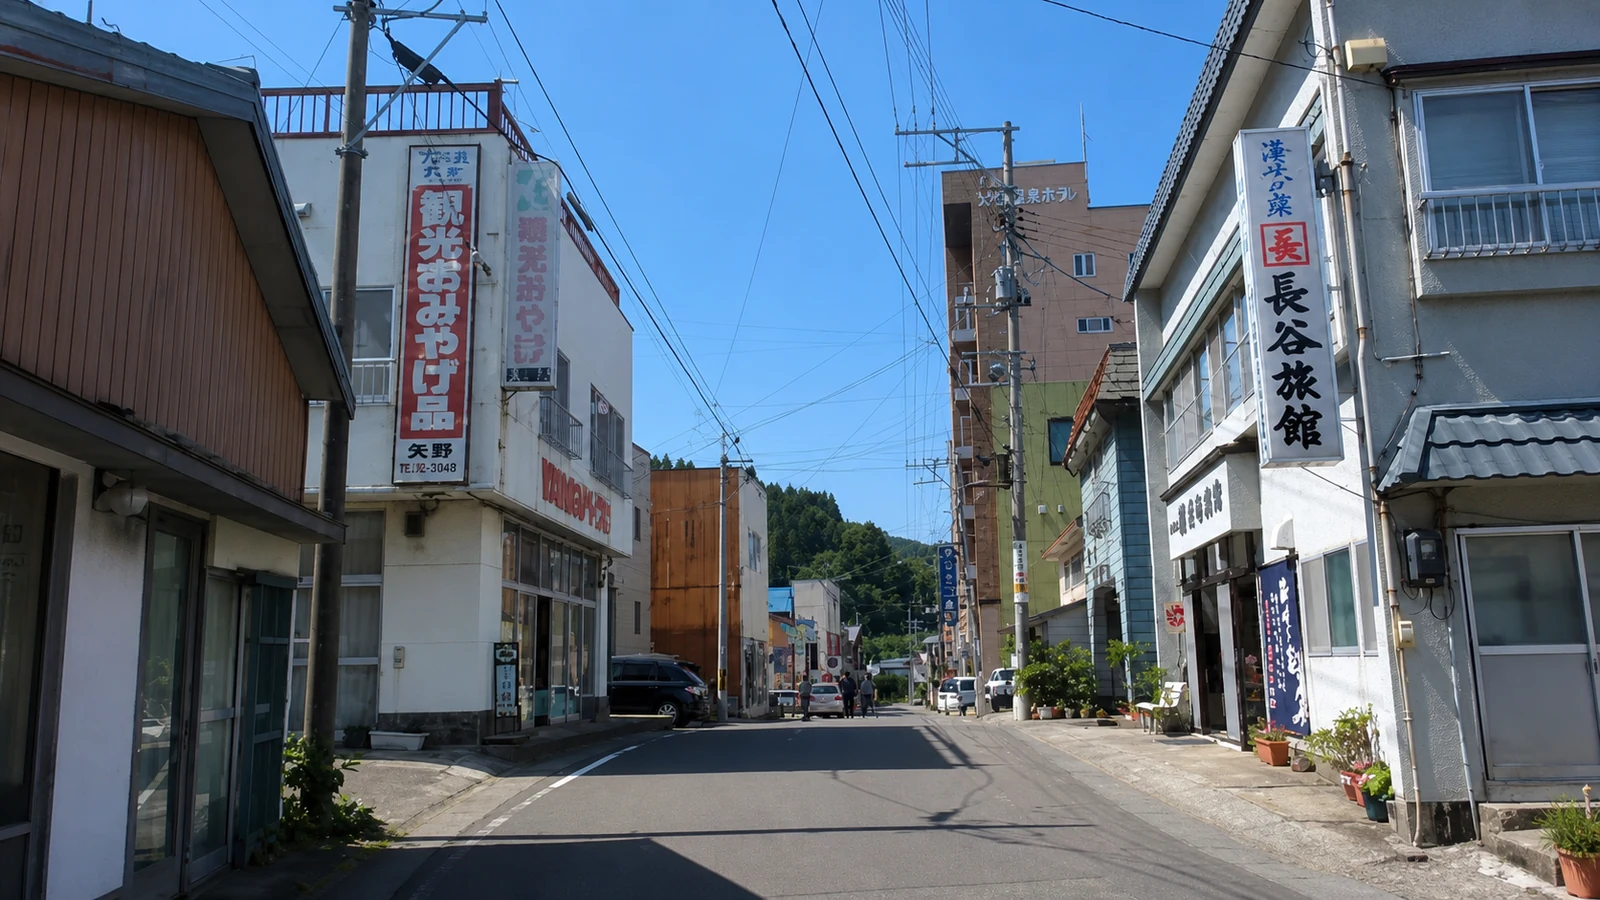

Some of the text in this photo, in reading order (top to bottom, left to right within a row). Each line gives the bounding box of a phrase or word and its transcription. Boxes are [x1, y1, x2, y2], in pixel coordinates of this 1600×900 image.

[410, 189, 465, 432] 観光おみやげ品
[1263, 271, 1323, 450] 長谷旅館
[407, 443, 453, 459] 矢野
